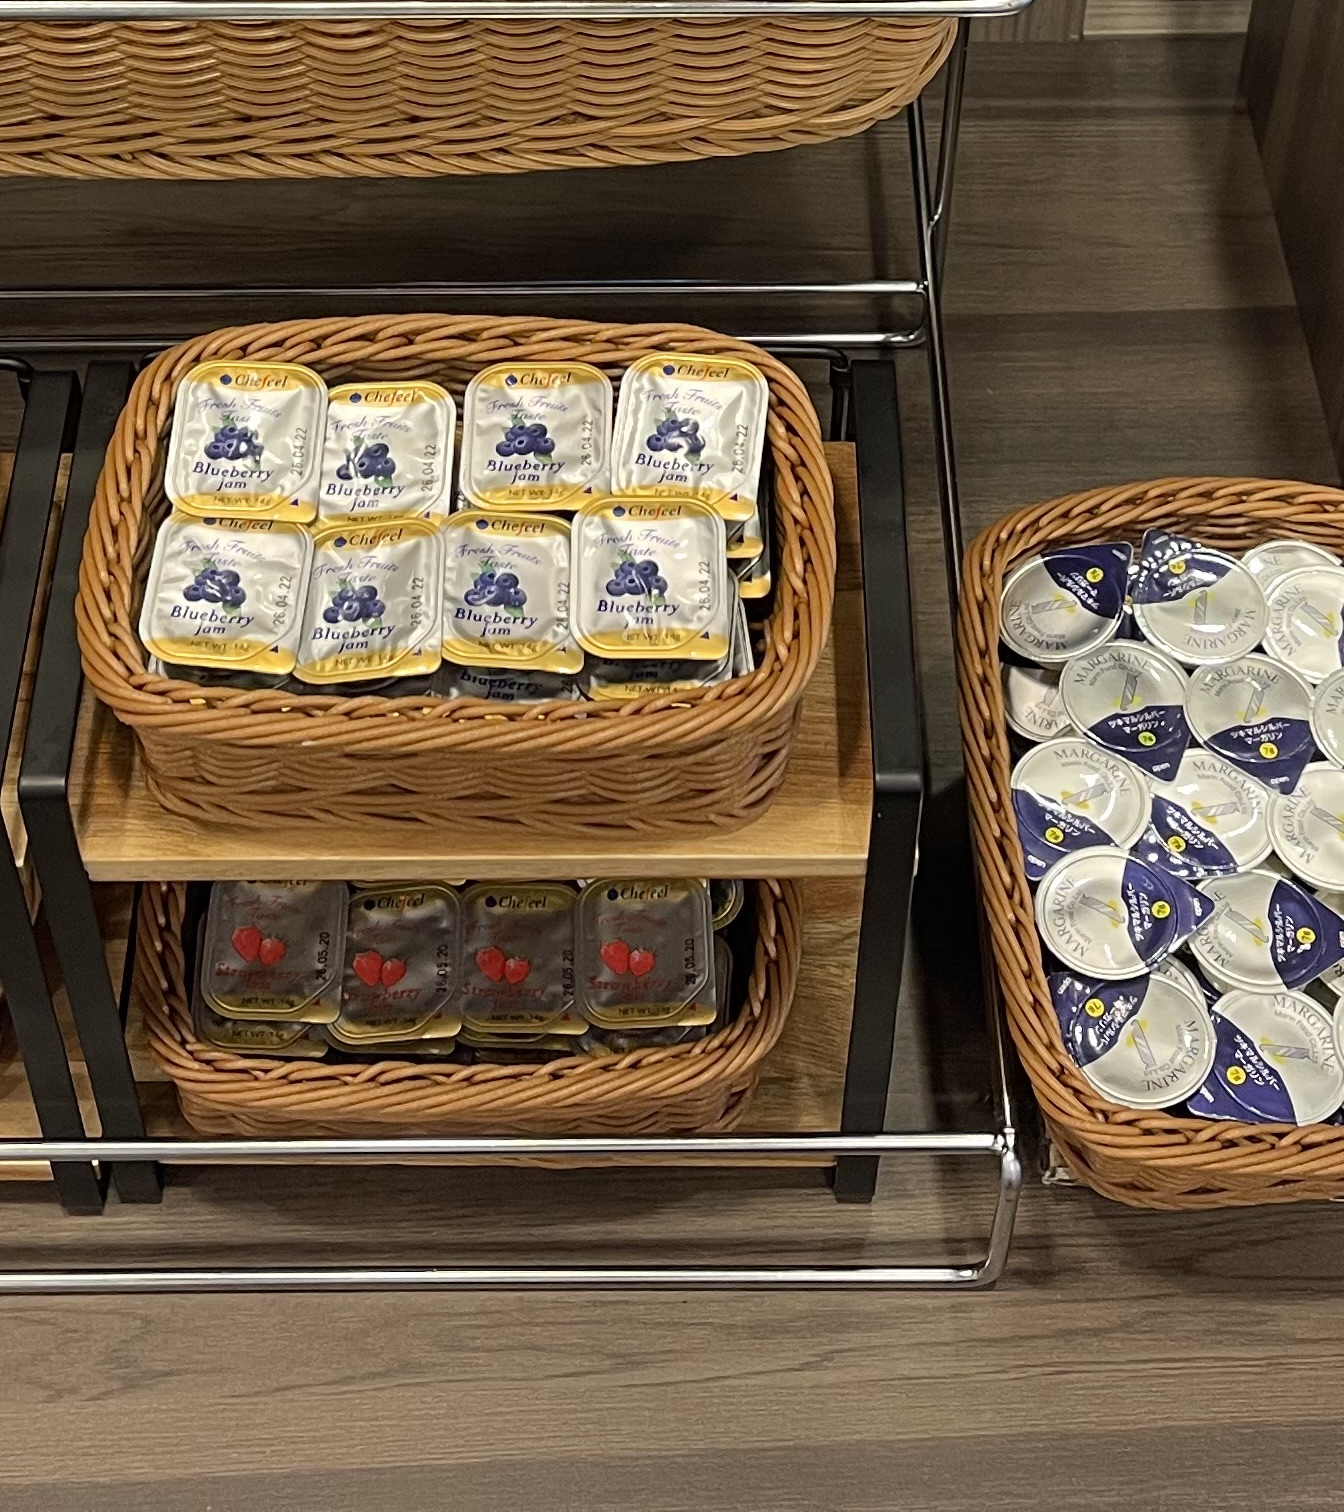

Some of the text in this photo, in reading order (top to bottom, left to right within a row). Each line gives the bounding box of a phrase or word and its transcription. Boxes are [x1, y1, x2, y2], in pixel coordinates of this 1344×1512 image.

[192, 462, 274, 482] Blueberry
[487, 459, 566, 474] Blueberry
[216, 481, 247, 491] jam
[512, 473, 540, 484] jam
[658, 471, 688, 483] jam
[326, 484, 405, 499] Blueberry
[350, 498, 379, 512] jam
[699, 561, 711, 610] 26.04.22
[273, 575, 292, 625] 26.04.22
[597, 600, 680, 616] Blueberry
[170, 606, 256, 628] Blueberry
[454, 608, 538, 629] Blueberry
[1271, 584, 1304, 656] MARGARINE
[194, 623, 226, 635] jam
[311, 625, 396, 640] Blueberry
[481, 624, 511, 637] jam
[1184, 609, 1256, 649] MARGARINE
[338, 640, 368, 653] jam
[1074, 652, 1151, 684] MARGARINE
[1200, 666, 1280, 695] MARGARINE
[1052, 876, 1089, 958] MARGARINE
[1273, 994, 1335, 1074] MARGARINE
[1141, 1020, 1200, 1091] MARGARINE
